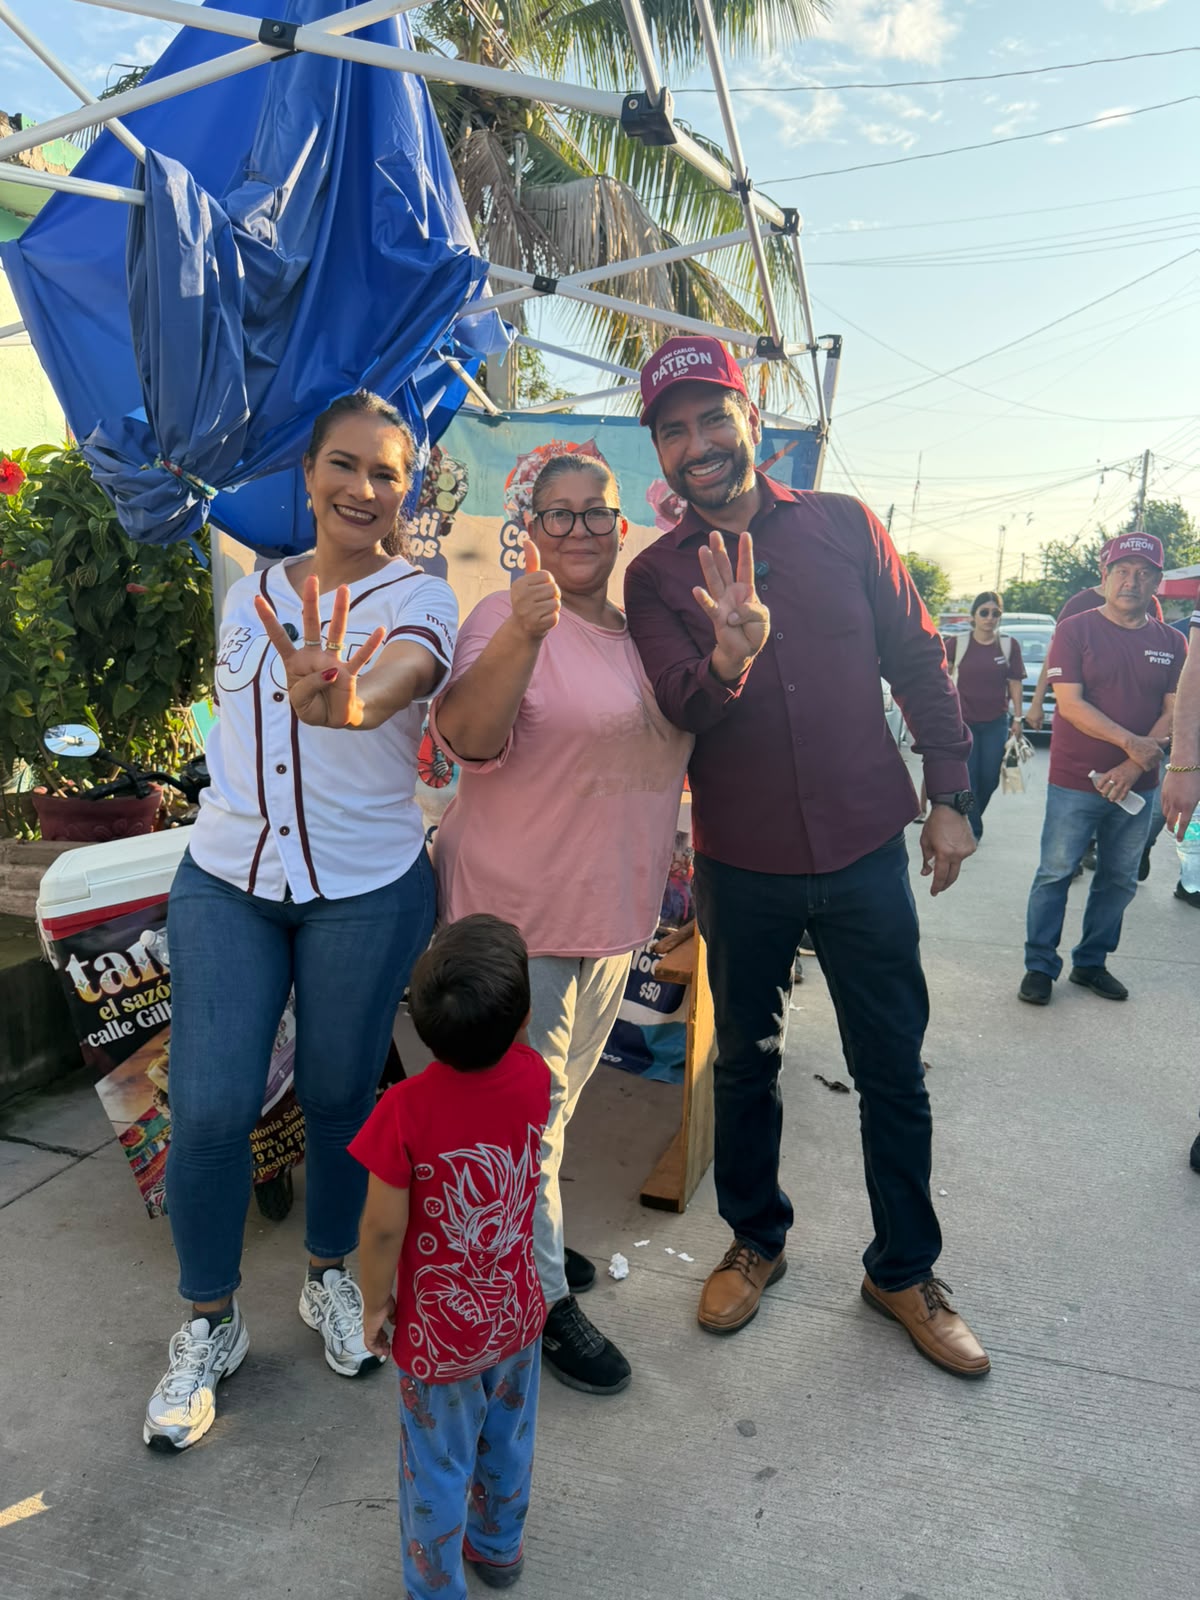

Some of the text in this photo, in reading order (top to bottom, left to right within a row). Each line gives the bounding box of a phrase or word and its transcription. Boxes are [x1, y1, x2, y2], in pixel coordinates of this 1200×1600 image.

[673, 346, 696, 356] CARLOS
[651, 352, 713, 386] PATRON
[406, 511, 440, 538] sti
[410, 538, 438, 559] os
[98, 980, 172, 1020] el sazó
[640, 981, 661, 1003] $50
[87, 1019, 136, 1047] calle
[249, 1120, 283, 1140] olonia
[251, 1137, 278, 1154] aloa,
[278, 1116, 305, 1140] núme
[256, 1152, 265, 1164] 9
